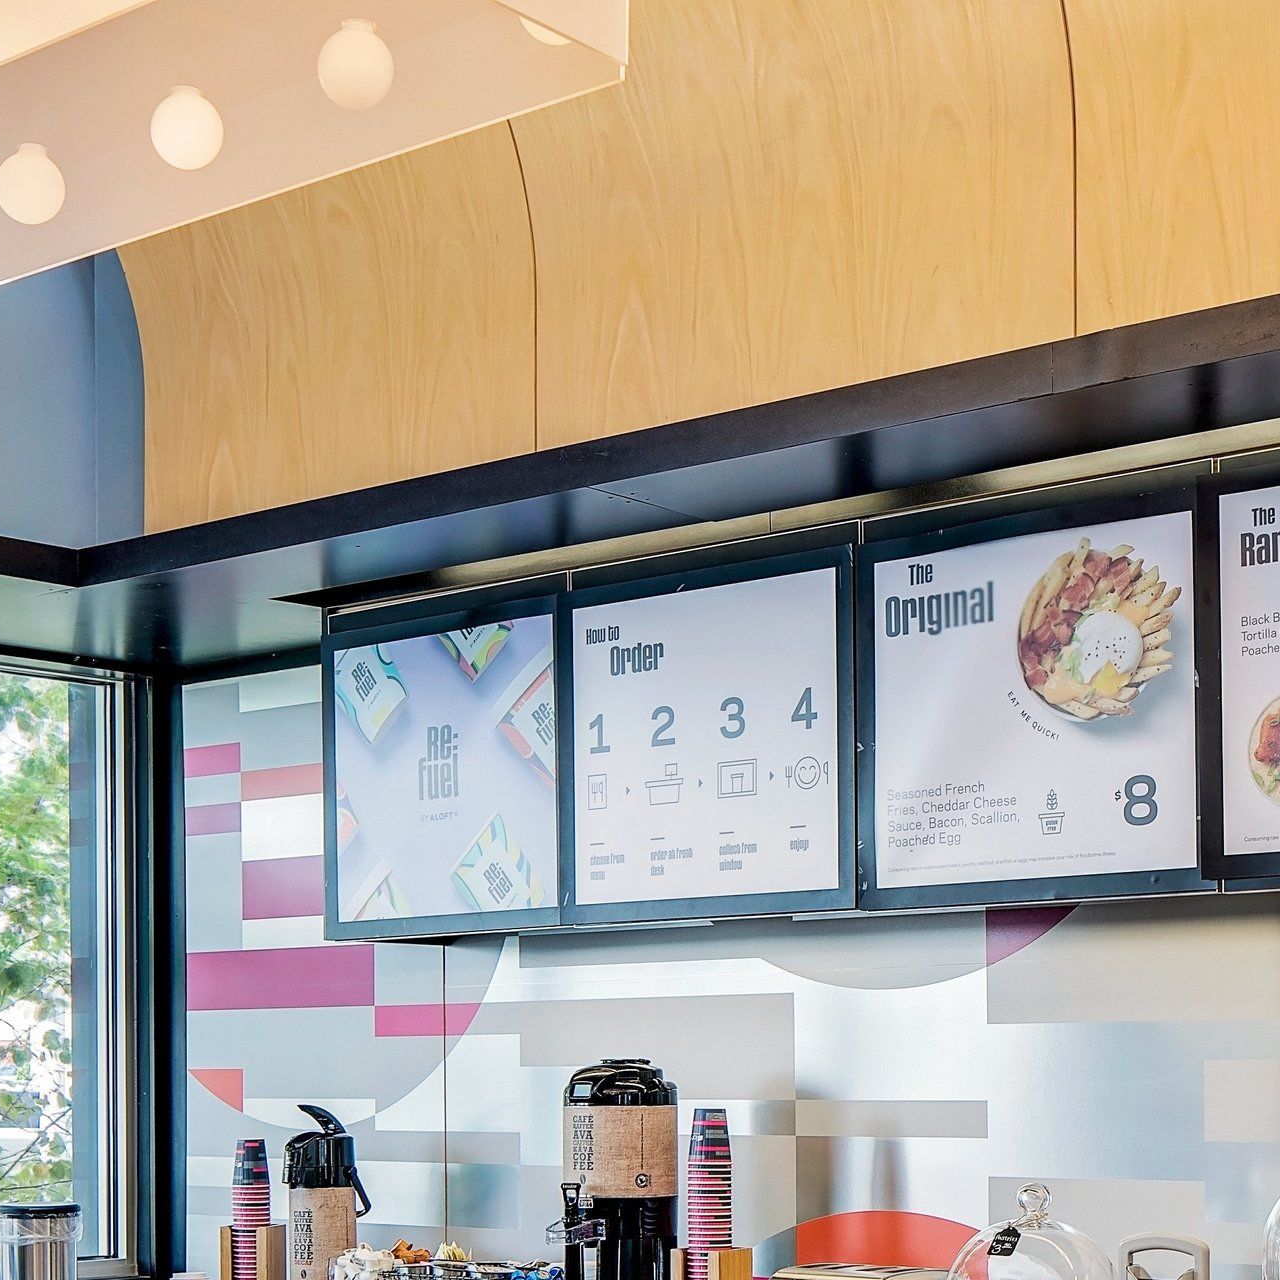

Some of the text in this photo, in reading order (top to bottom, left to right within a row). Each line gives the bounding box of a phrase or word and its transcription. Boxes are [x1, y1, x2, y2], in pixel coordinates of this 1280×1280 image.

[1251, 507, 1275, 527] The
[908, 564, 933, 586] The
[885, 581, 994, 638] Original
[1241, 614, 1270, 627] Black
[586, 625, 620, 645] How to
[1241, 629, 1277, 642] Tortilla
[610, 641, 664, 676] Order
[355, 669, 377, 702] fuel
[589, 687, 818, 754] 1 2 3 4
[1008, 691, 1059, 741] EAT ME QUICK!
[427, 724, 459, 762] Re:
[419, 753, 459, 801] fuel
[887, 781, 985, 801] Seasoned French
[887, 796, 1017, 816] Fries, Cheddar Cheese
[888, 812, 1020, 833] Sauce, Bacon, Scallion,
[719, 842, 757, 856] collect from
[888, 832, 961, 848] Poached Egg
[610, 853, 625, 864] from
[719, 859, 743, 871] window
[651, 865, 665, 876] desk
[488, 871, 513, 904] fuel
[573, 1114, 594, 1123] CAFÉ
[573, 1130, 594, 1140] AVA
[573, 1153, 594, 1161] COF
[573, 1162, 594, 1171] FEE
[294, 1209, 313, 1218] CAFÉ
[294, 1224, 313, 1232] AVA
